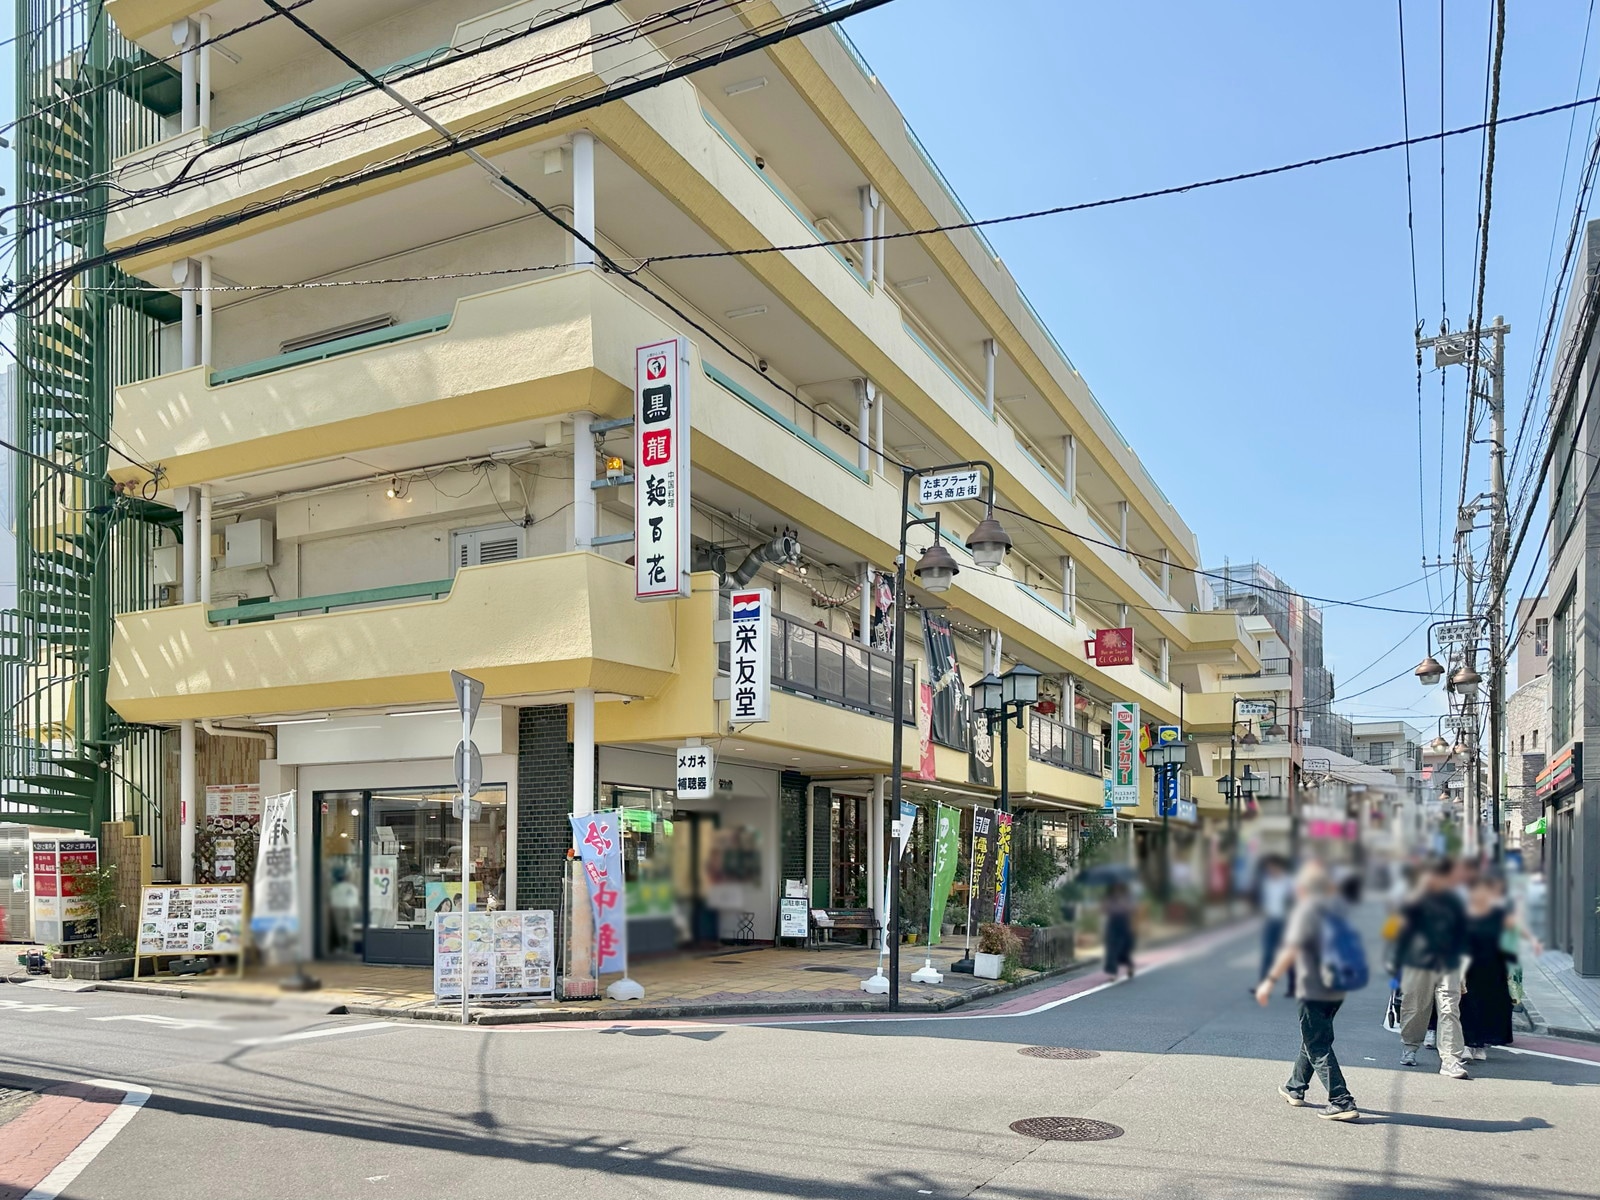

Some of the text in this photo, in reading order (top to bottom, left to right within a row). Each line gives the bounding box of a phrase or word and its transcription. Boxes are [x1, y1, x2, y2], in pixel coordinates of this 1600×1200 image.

[923, 472, 978, 490] たまプラーザ
[923, 484, 978, 500] 中央商店街
[735, 624, 757, 717] 栄友堂
[678, 754, 707, 769] メガネ
[1119, 729, 1133, 784] フジカラー
[677, 776, 707, 791] 補聴器
